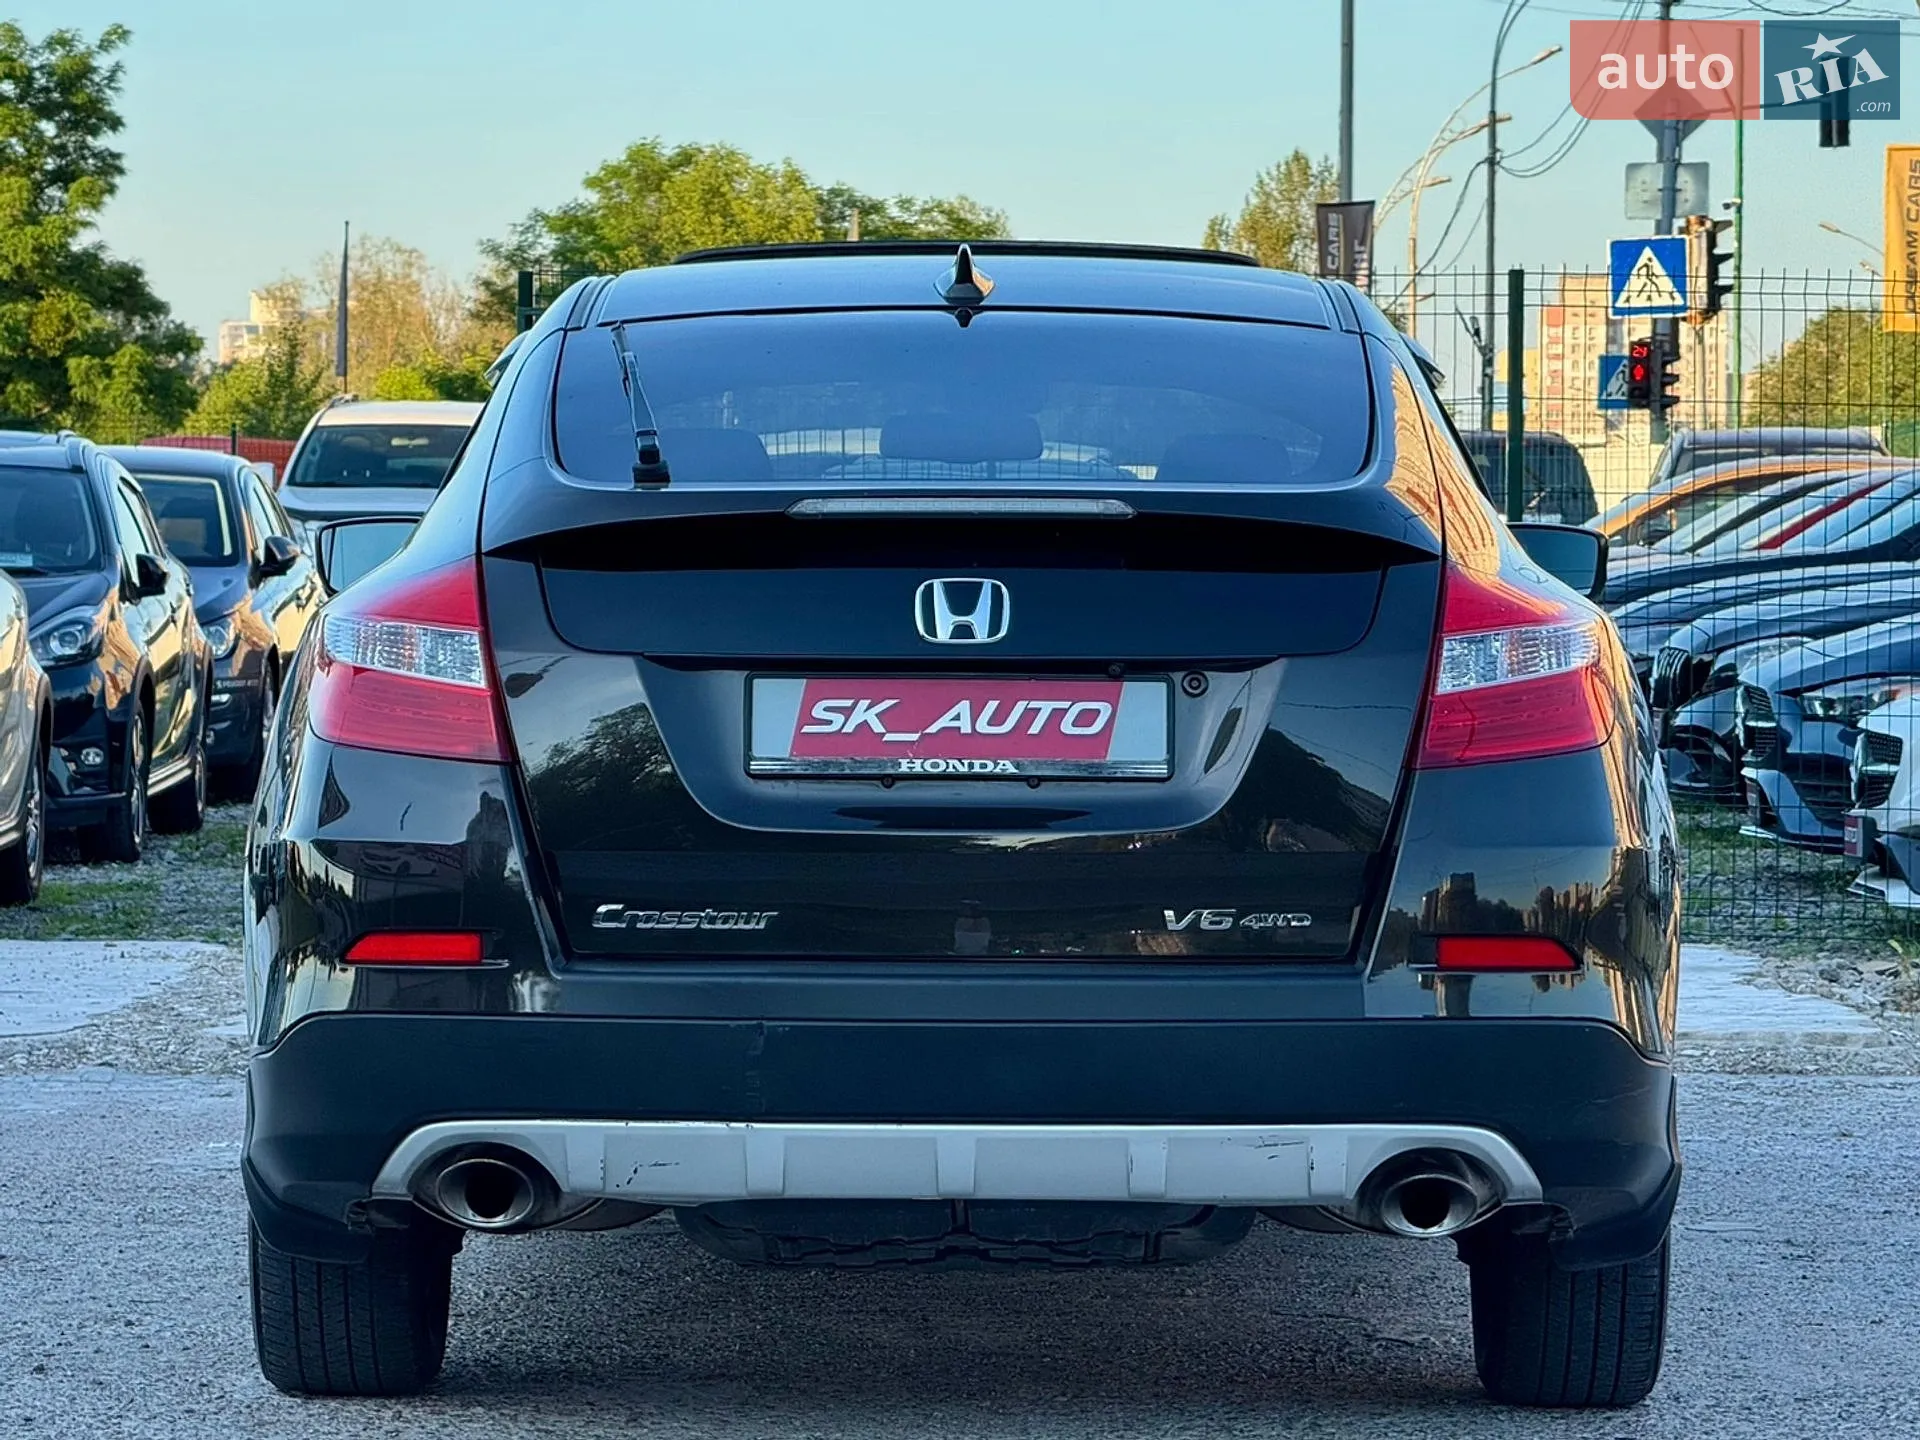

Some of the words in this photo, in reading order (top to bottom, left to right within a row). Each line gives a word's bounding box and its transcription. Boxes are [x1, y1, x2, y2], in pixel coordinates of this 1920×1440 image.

[1326, 212, 1339, 270] CARS
[800, 699, 1114, 741] SK_AUTO
[898, 758, 1019, 774] HONDA
[592, 904, 779, 930] Crosstour
[1163, 909, 1237, 931] V6
[1239, 913, 1312, 929] 4WD
